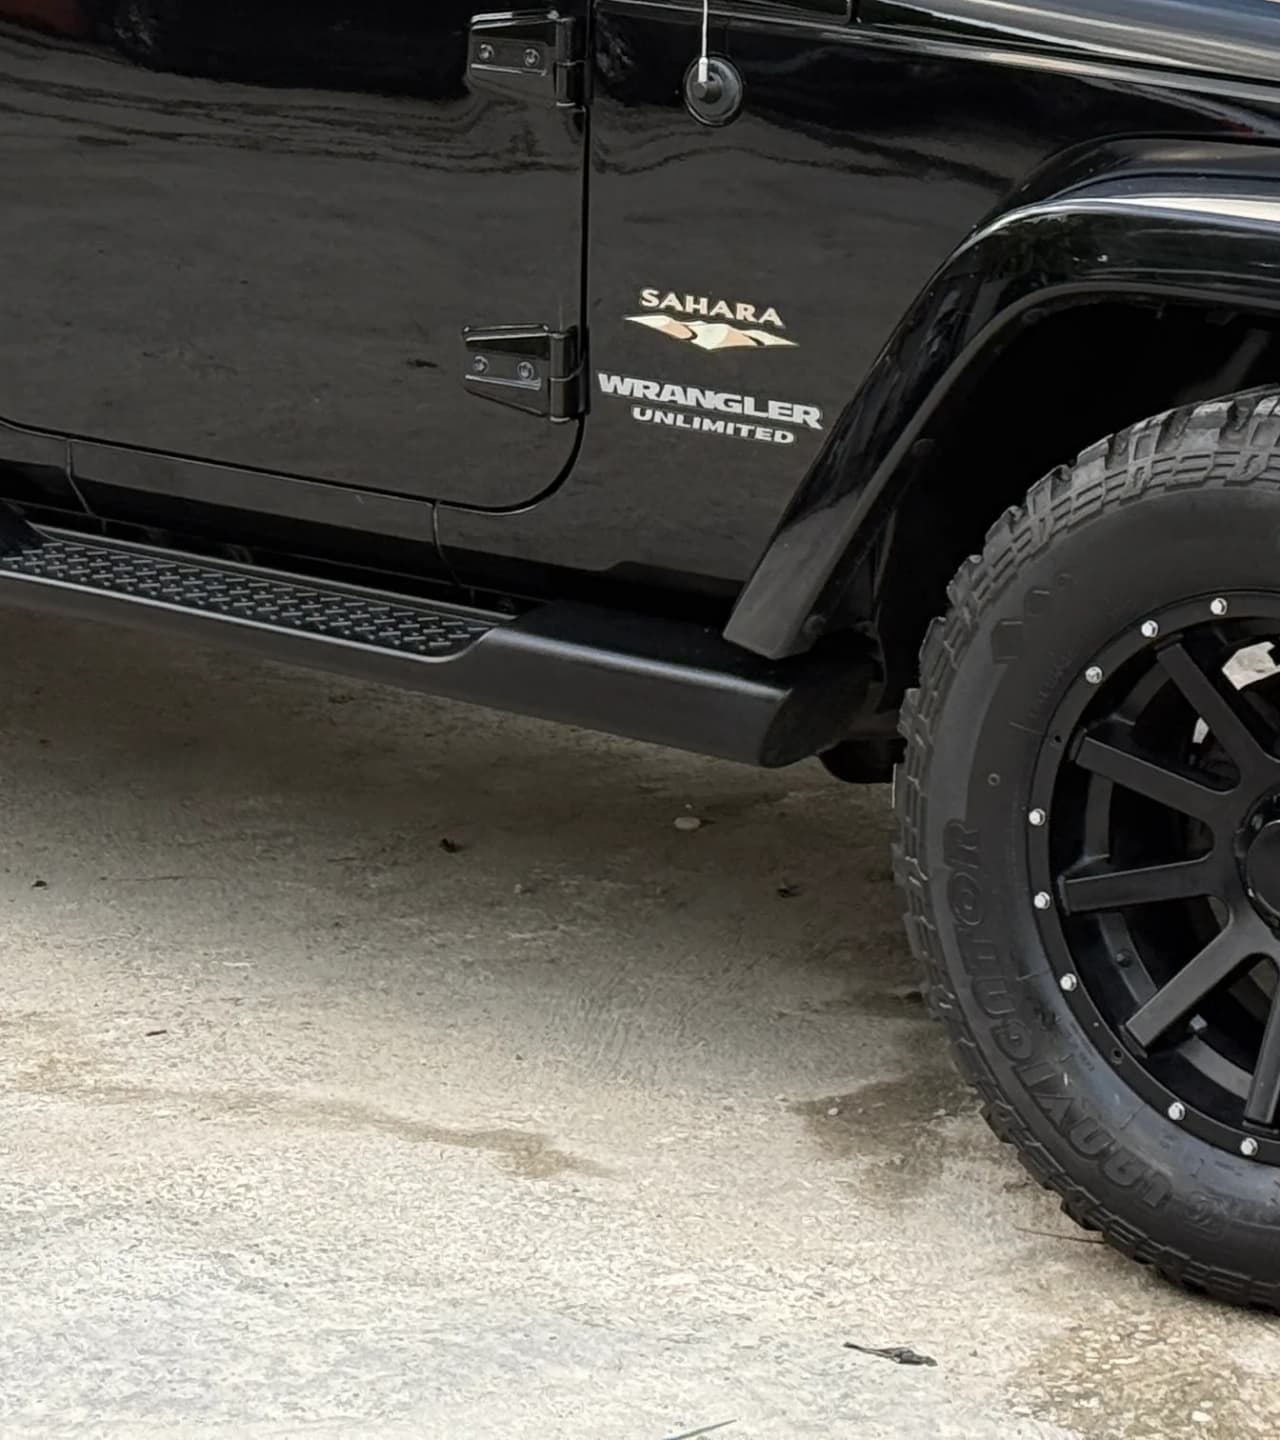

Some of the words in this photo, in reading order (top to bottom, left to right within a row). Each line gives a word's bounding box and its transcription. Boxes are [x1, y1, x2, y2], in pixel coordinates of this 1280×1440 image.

[640, 288, 784, 329] SAHARA
[597, 372, 823, 430] WRANGLER
[631, 406, 795, 444] UNLIMITED
